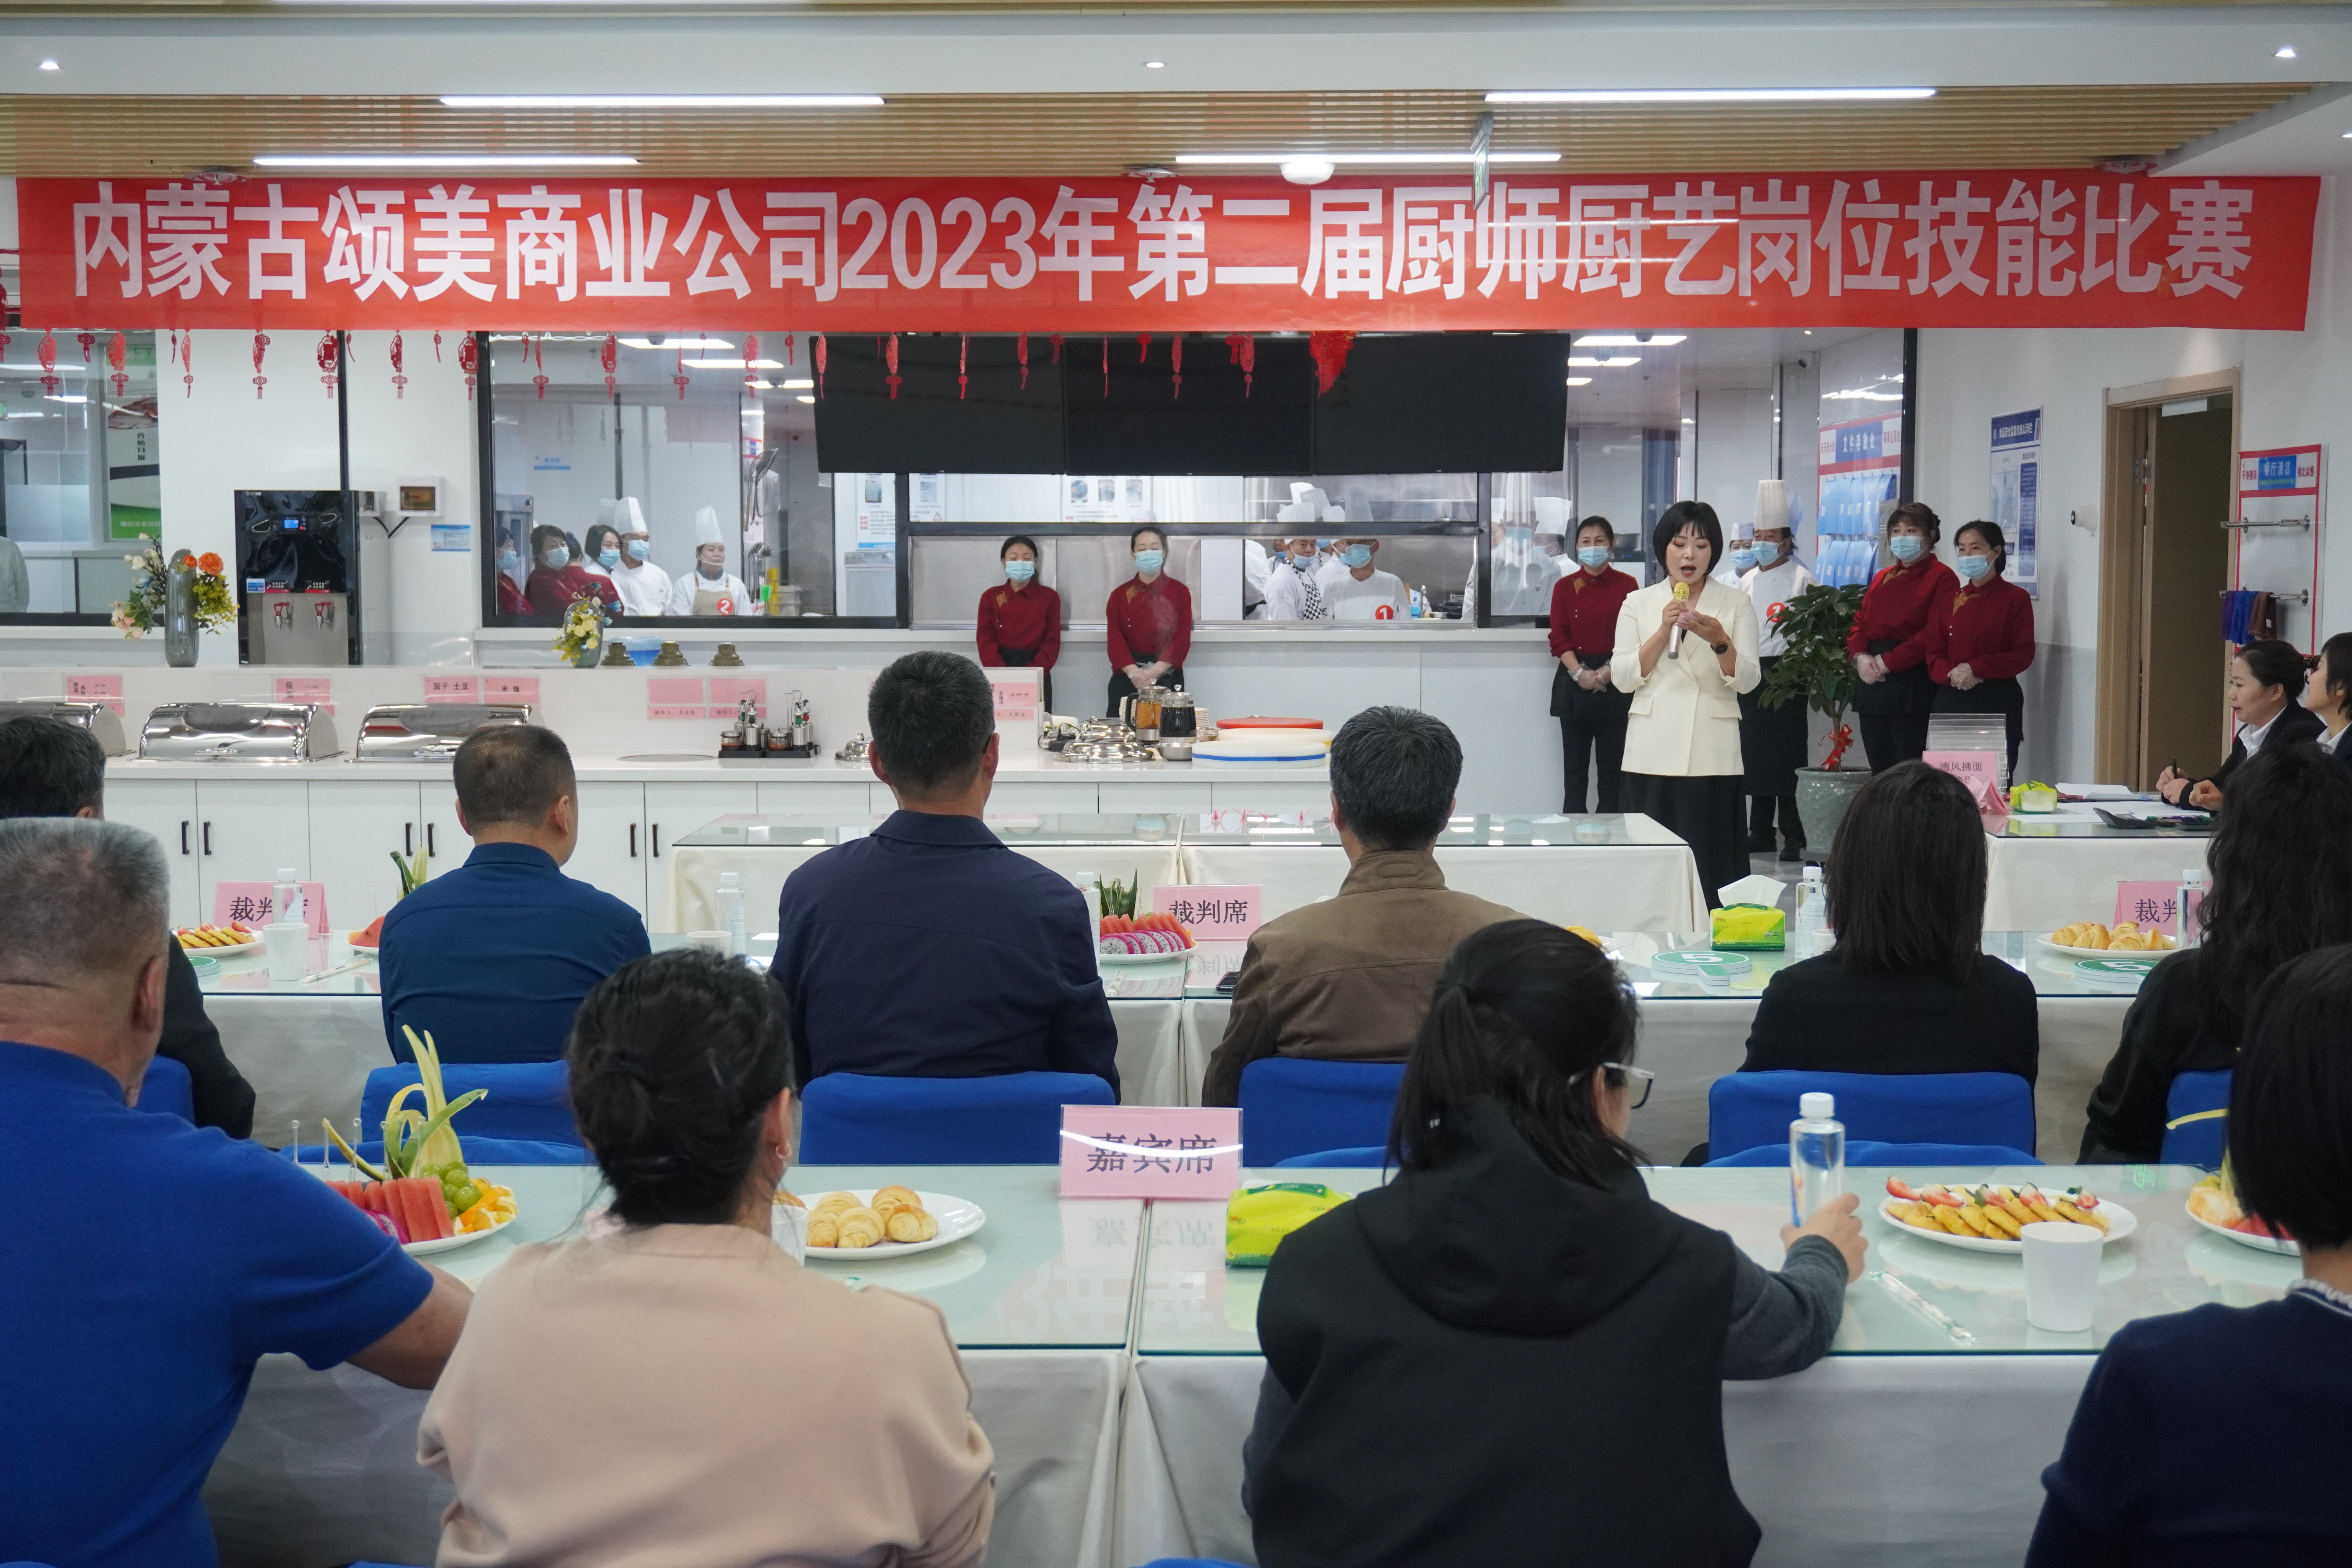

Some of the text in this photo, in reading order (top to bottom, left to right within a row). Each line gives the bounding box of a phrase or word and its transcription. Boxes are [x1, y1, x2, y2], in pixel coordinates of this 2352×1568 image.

[73, 179, 2254, 303] 内蒙古颂美商业公司2023年第二届厨师厨艺岗位技能比赛
[2264, 459, 2291, 477] 餐厅清洁
[720, 600, 730, 614] 2
[1379, 607, 1387, 620] 1
[433, 682, 448, 690] 茄子
[1940, 761, 1982, 772] 清风拂面
[1168, 899, 1248, 924] 裁判席
[1681, 953, 1723, 962] 5
[2100, 961, 2152, 971] 5
[1087, 1132, 1218, 1174] 嘉宾席
